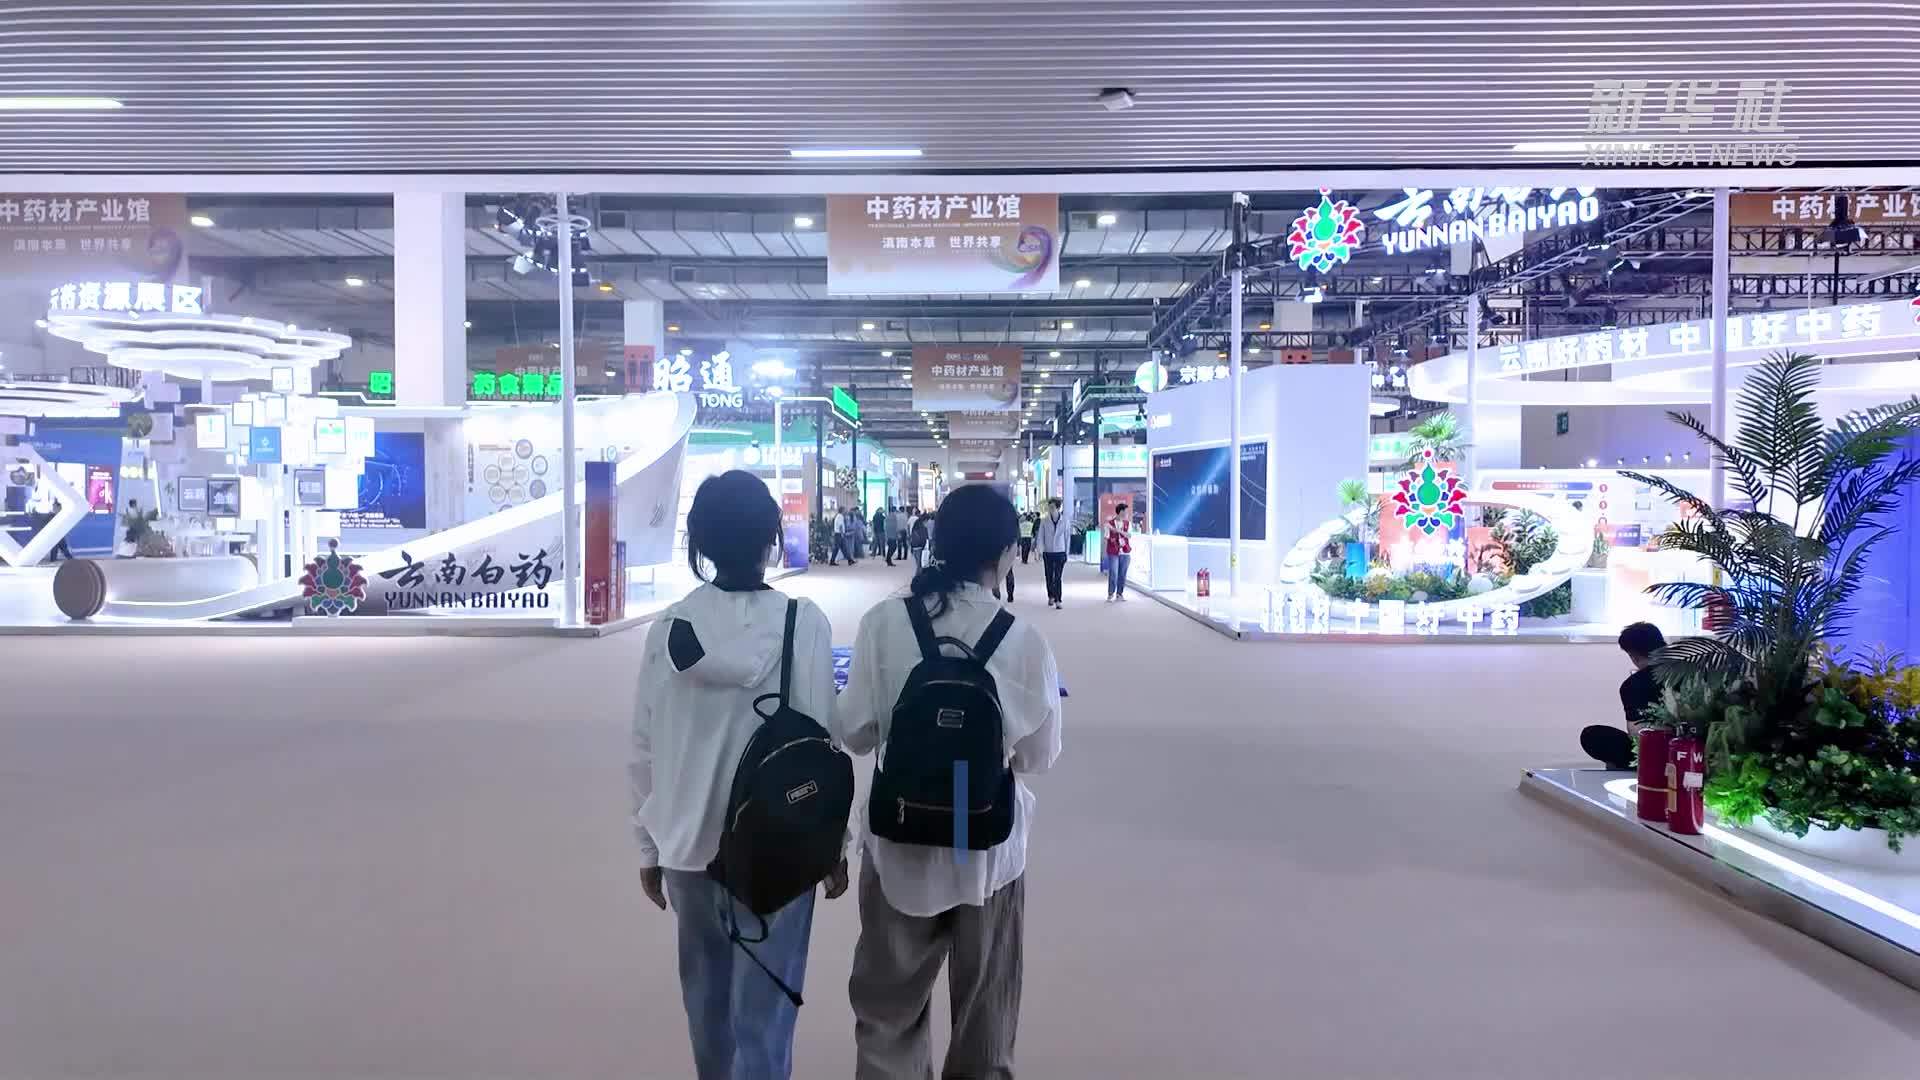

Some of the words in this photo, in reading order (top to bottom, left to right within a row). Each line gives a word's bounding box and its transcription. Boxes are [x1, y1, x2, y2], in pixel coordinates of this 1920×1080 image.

[0, 199, 150, 222] 中药材产业馆
[867, 195, 1020, 220] 中药材产业馆
[1381, 217, 1484, 256] YUNNAN
[1488, 196, 1599, 238] BAIYAO
[653, 350, 742, 392] 昭通
[700, 393, 744, 408] TONG
[378, 549, 553, 590] 云南白药
[385, 591, 467, 609] YUNNAN
[471, 591, 549, 609] BAIYAO
[1677, 751, 1688, 761] F
